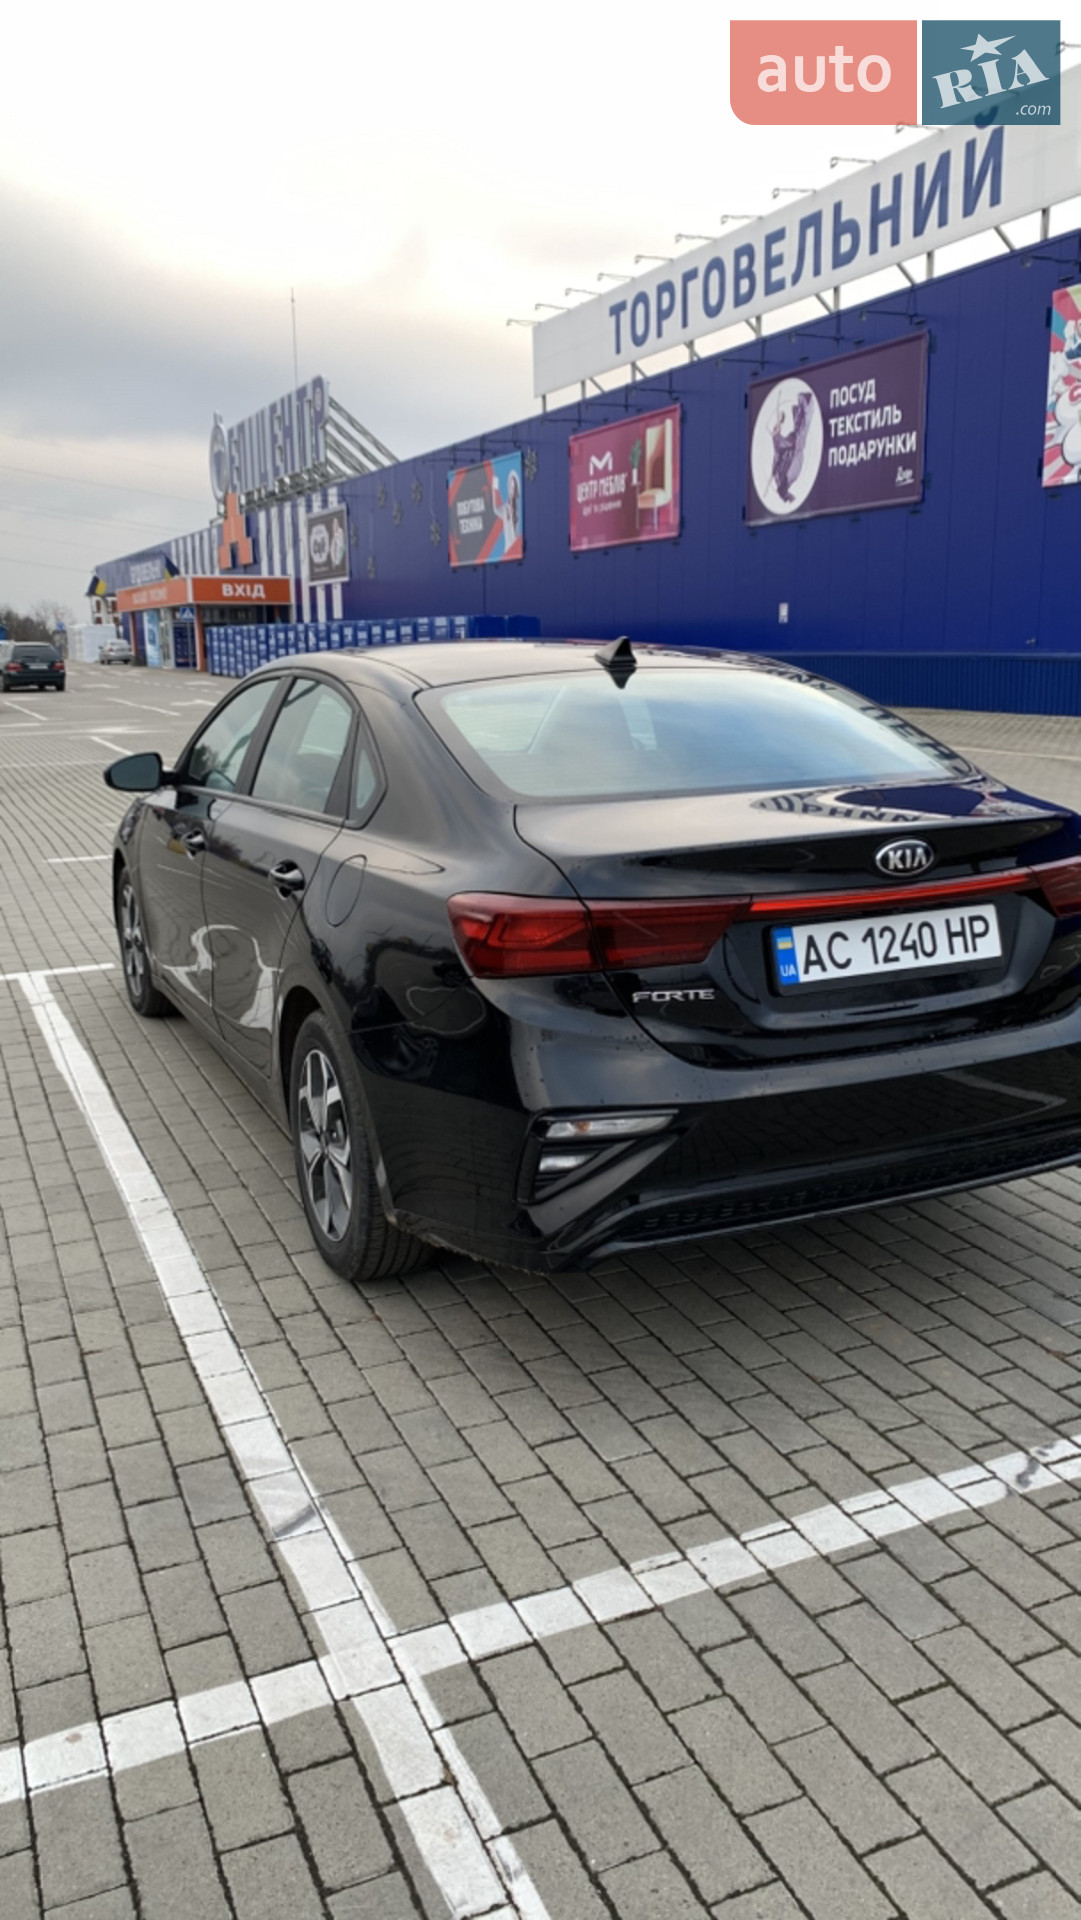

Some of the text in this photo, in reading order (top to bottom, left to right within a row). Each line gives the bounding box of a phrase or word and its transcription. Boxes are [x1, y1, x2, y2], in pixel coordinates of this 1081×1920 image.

[608, 106, 1005, 356] ТОРГОВЕЛЬНИЙ
[829, 378, 877, 409] ПОСУД
[828, 403, 903, 438] ТЕКСТИЛЬ
[828, 430, 918, 468] ПОДАРУНКИ
[222, 582, 266, 600] ВХІД
[889, 848, 927, 870] KIA
[803, 914, 990, 976] AC 1240 HP
[781, 964, 797, 977] UA
[632, 989, 715, 1003] FORTE
